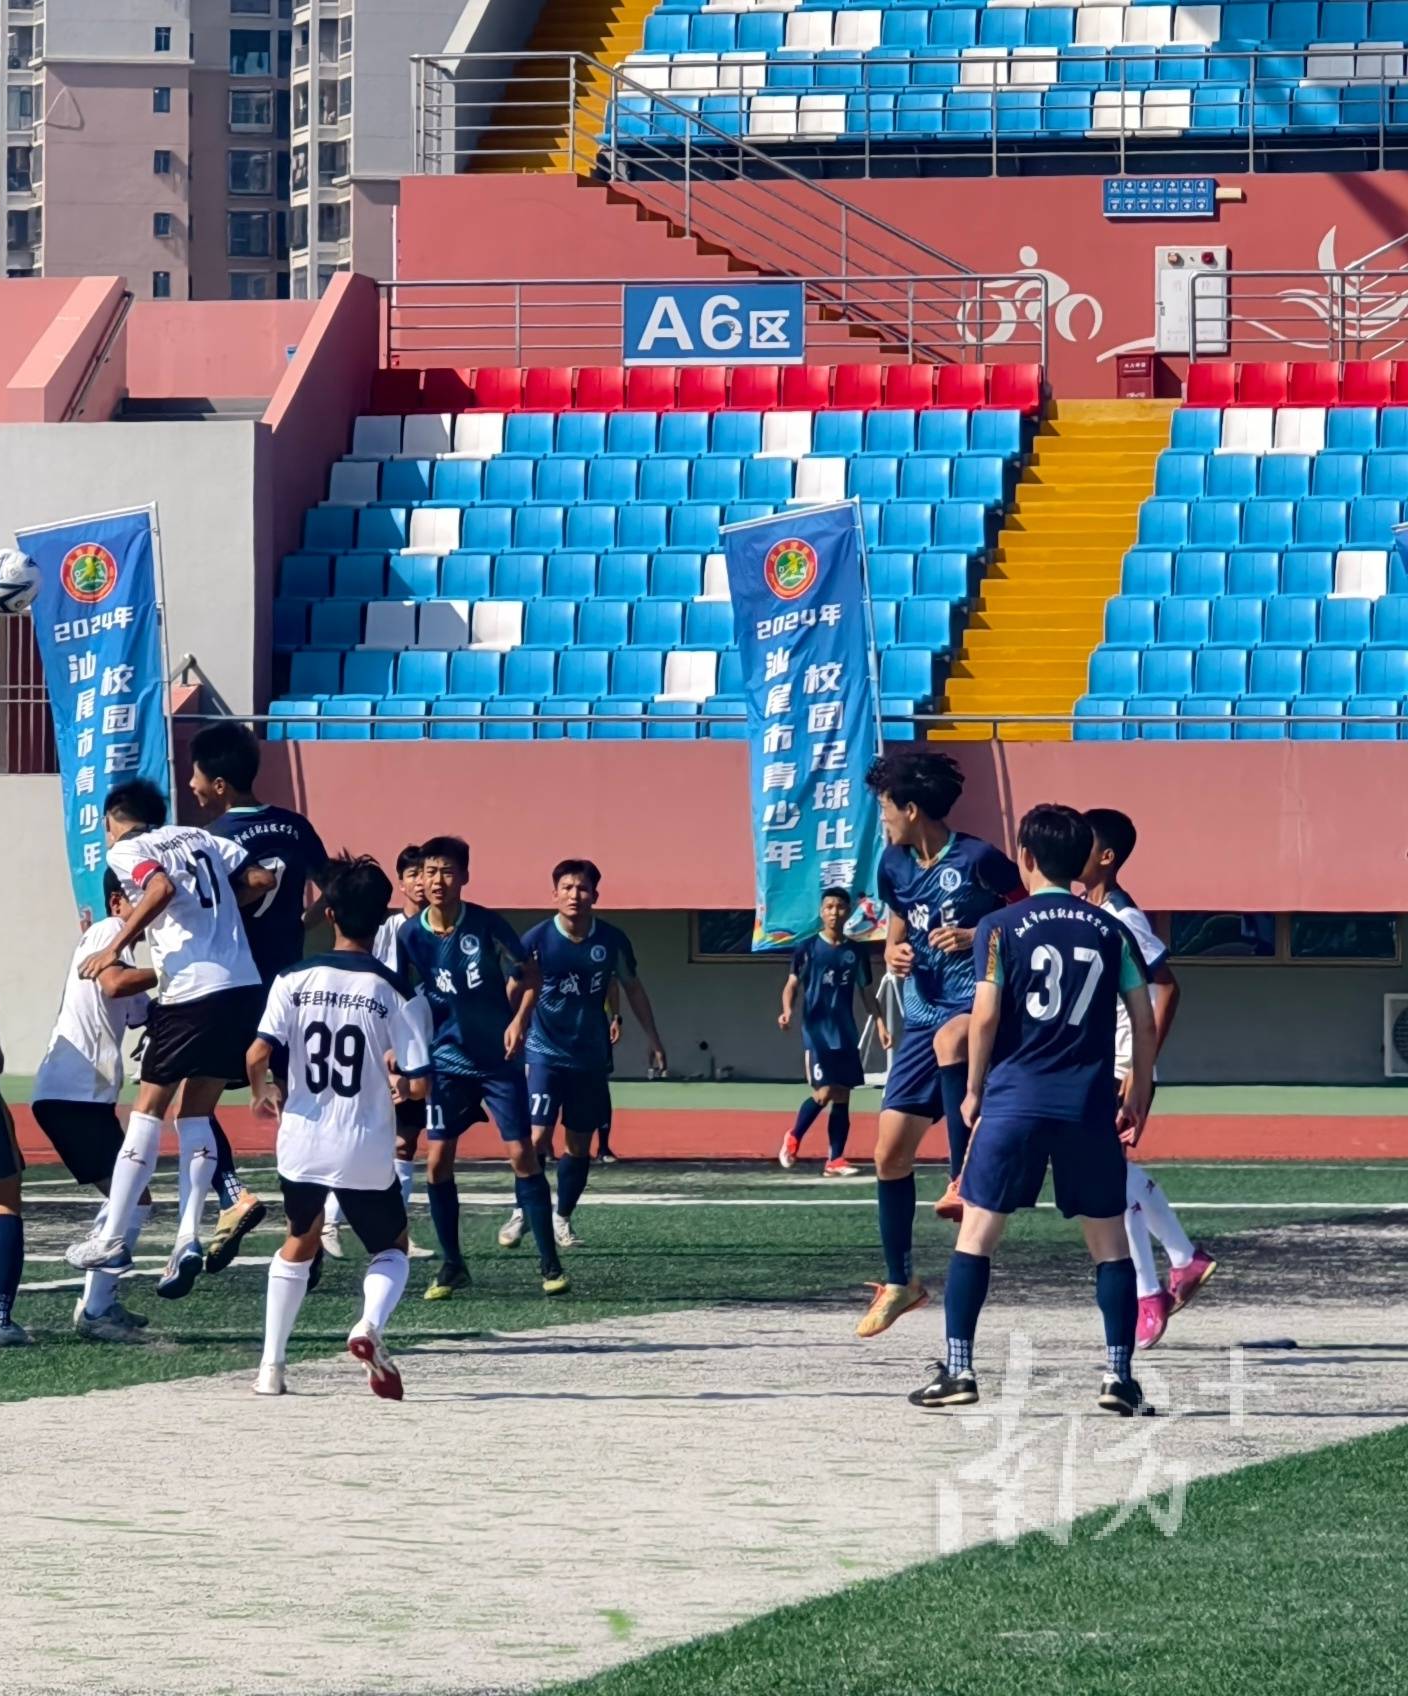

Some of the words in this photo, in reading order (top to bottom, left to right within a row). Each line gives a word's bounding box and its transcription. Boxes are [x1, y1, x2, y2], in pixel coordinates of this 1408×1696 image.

[637, 294, 790, 350] A6区
[54, 606, 134, 642] 2024年
[756, 603, 841, 640] 2024年
[100, 664, 140, 788] 校园足
[67, 653, 103, 873] 汕尾市青少年
[762, 647, 804, 870] 汕尾市青少年
[803, 662, 857, 889] 校园足球比赛
[434, 961, 484, 996] 城区
[1025, 943, 1104, 1027] 37
[304, 1021, 366, 1097] 39
[812, 1063, 824, 1081] 6
[425, 1104, 445, 1129] 11
[531, 1093, 550, 1116] 77
